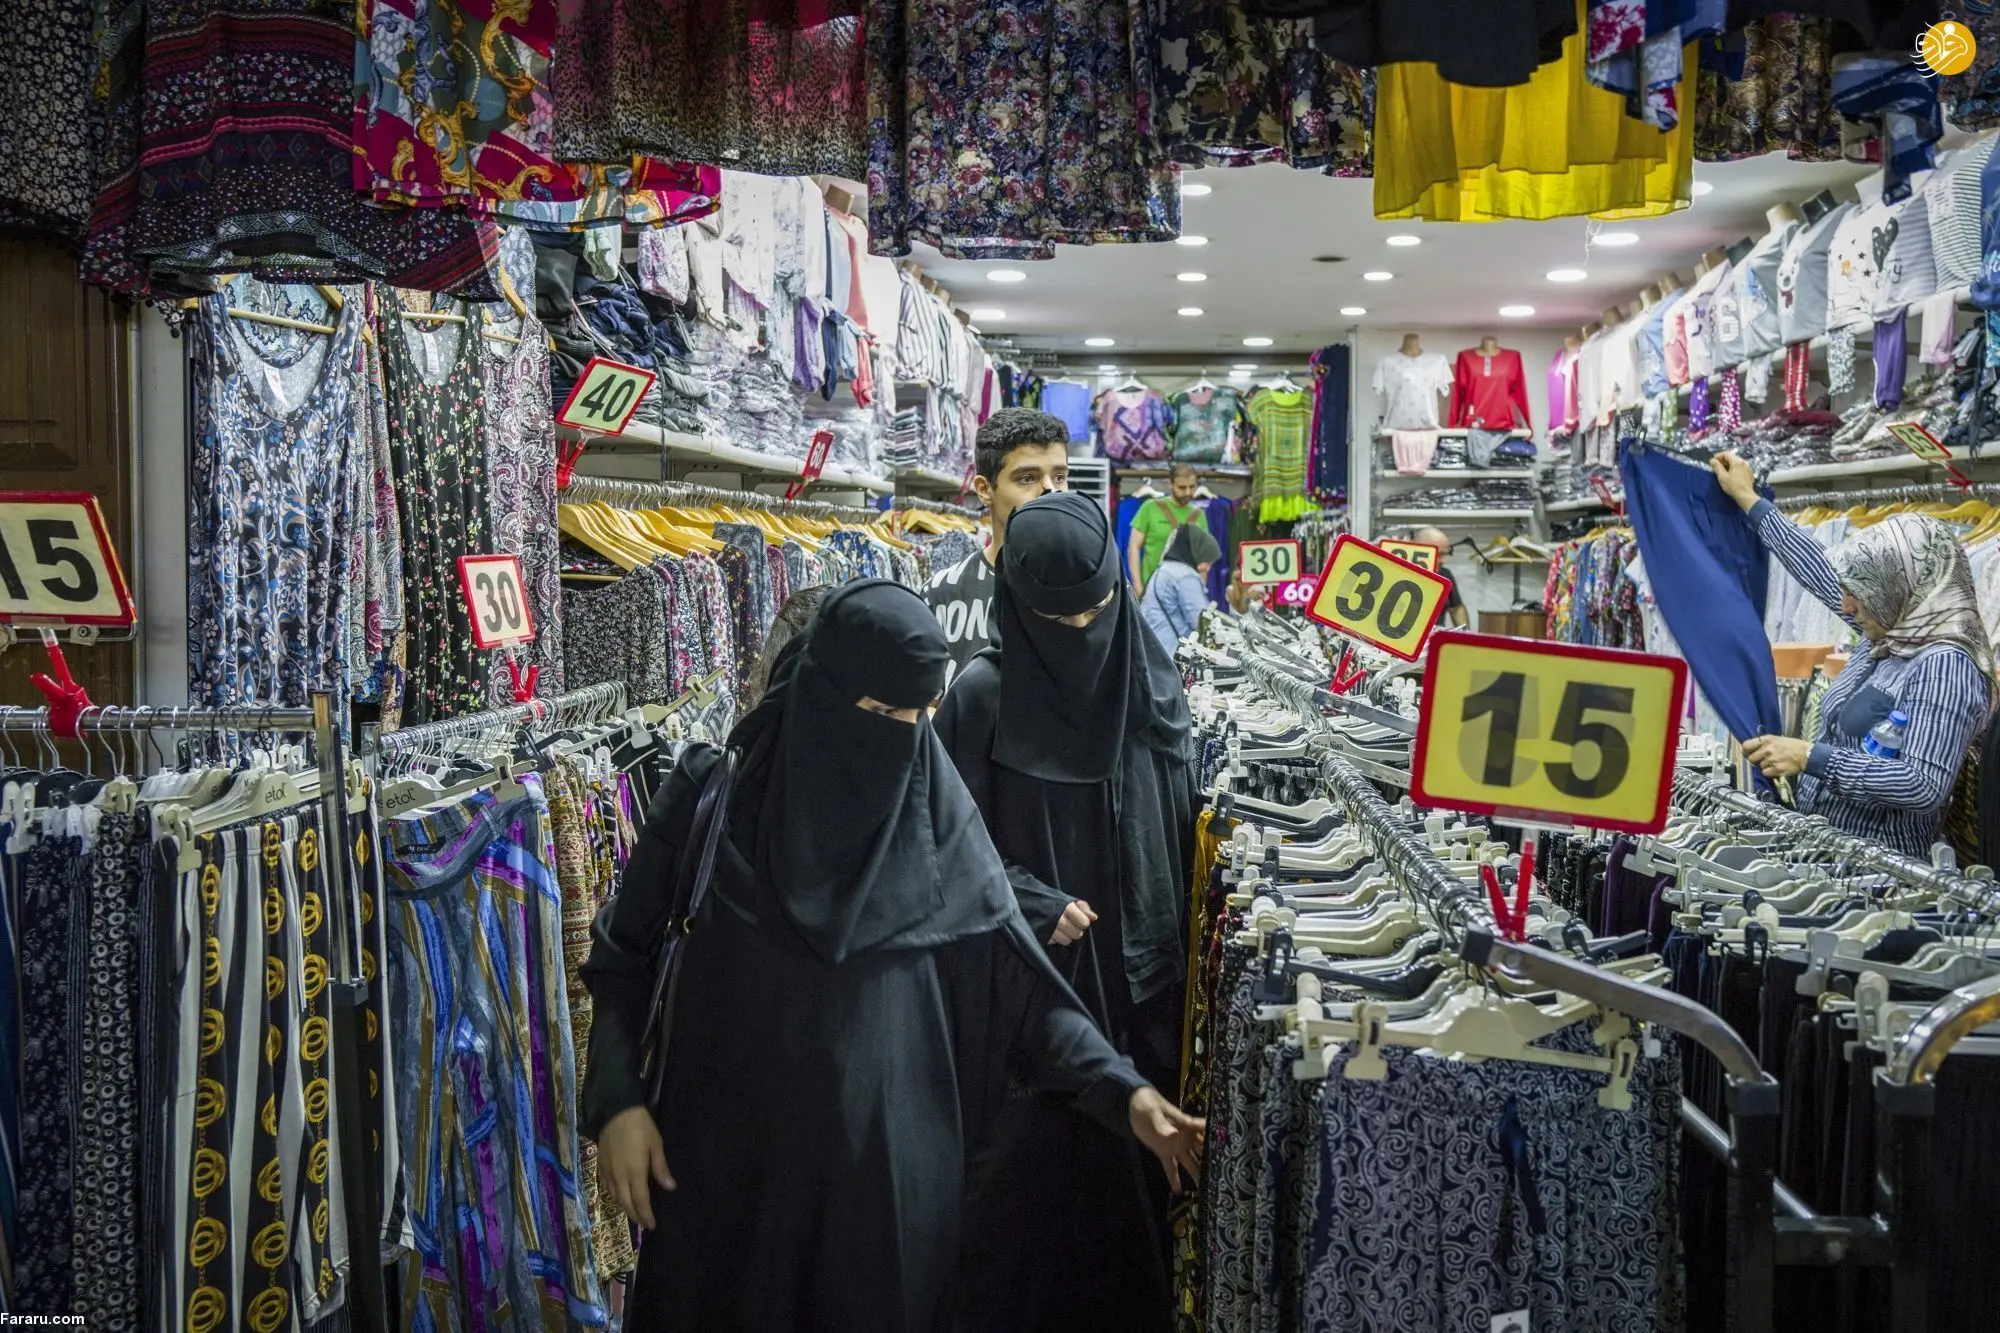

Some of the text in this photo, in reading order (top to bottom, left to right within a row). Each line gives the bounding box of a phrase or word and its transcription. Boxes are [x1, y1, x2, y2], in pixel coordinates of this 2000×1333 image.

[579, 373, 636, 423] 40
[809, 441, 826, 469] 60
[1897, 427, 1938, 453] 35
[0, 519, 99, 602] 15
[1250, 546, 1291, 577] 30
[475, 570, 522, 633] 30
[1283, 582, 1314, 603] 60
[1335, 561, 1424, 640] 30
[1461, 671, 1635, 799] 15
[386, 788, 416, 809] etol
